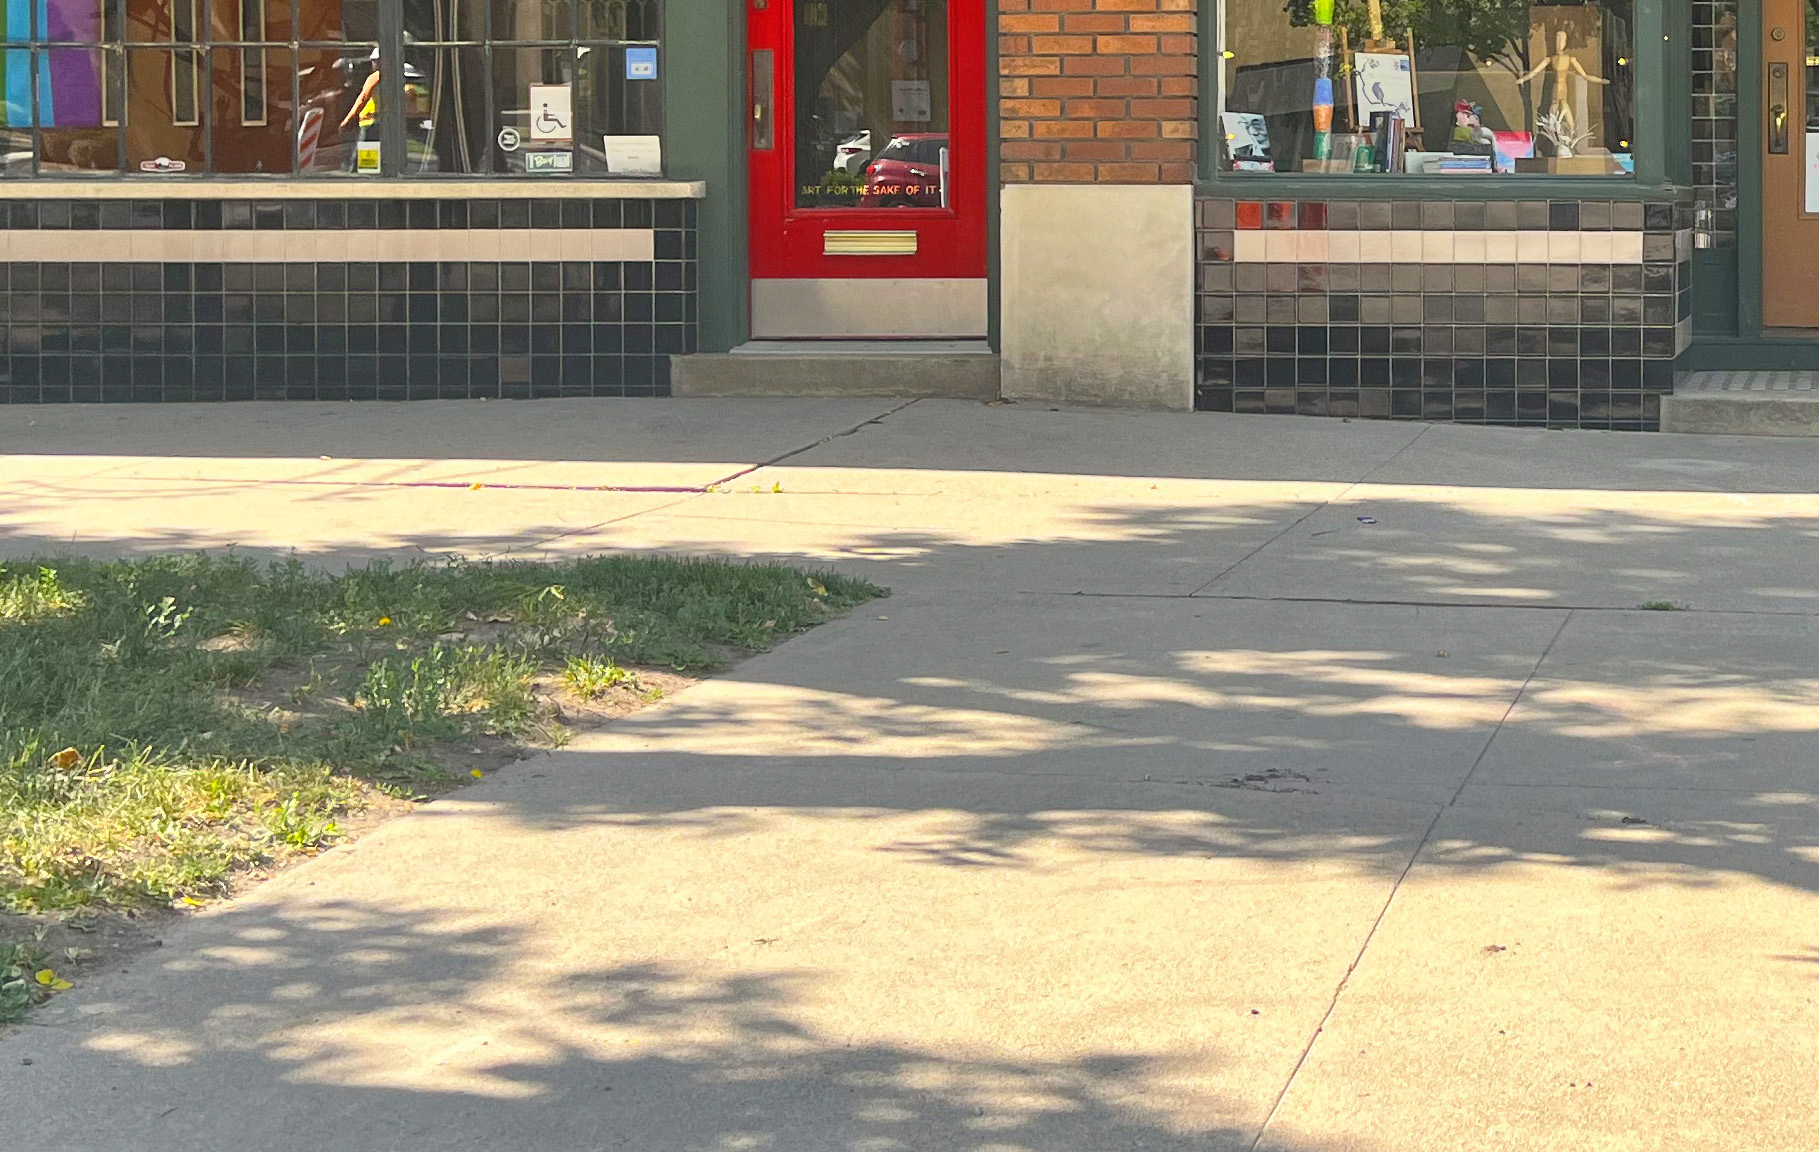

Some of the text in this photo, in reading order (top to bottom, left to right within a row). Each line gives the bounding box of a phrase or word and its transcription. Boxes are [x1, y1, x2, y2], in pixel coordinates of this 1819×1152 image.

[801, 185, 821, 195] ART
[826, 185, 849, 195] FOR
[850, 184, 870, 196] THE
[905, 185, 921, 195] OF
[925, 185, 937, 195] IT
